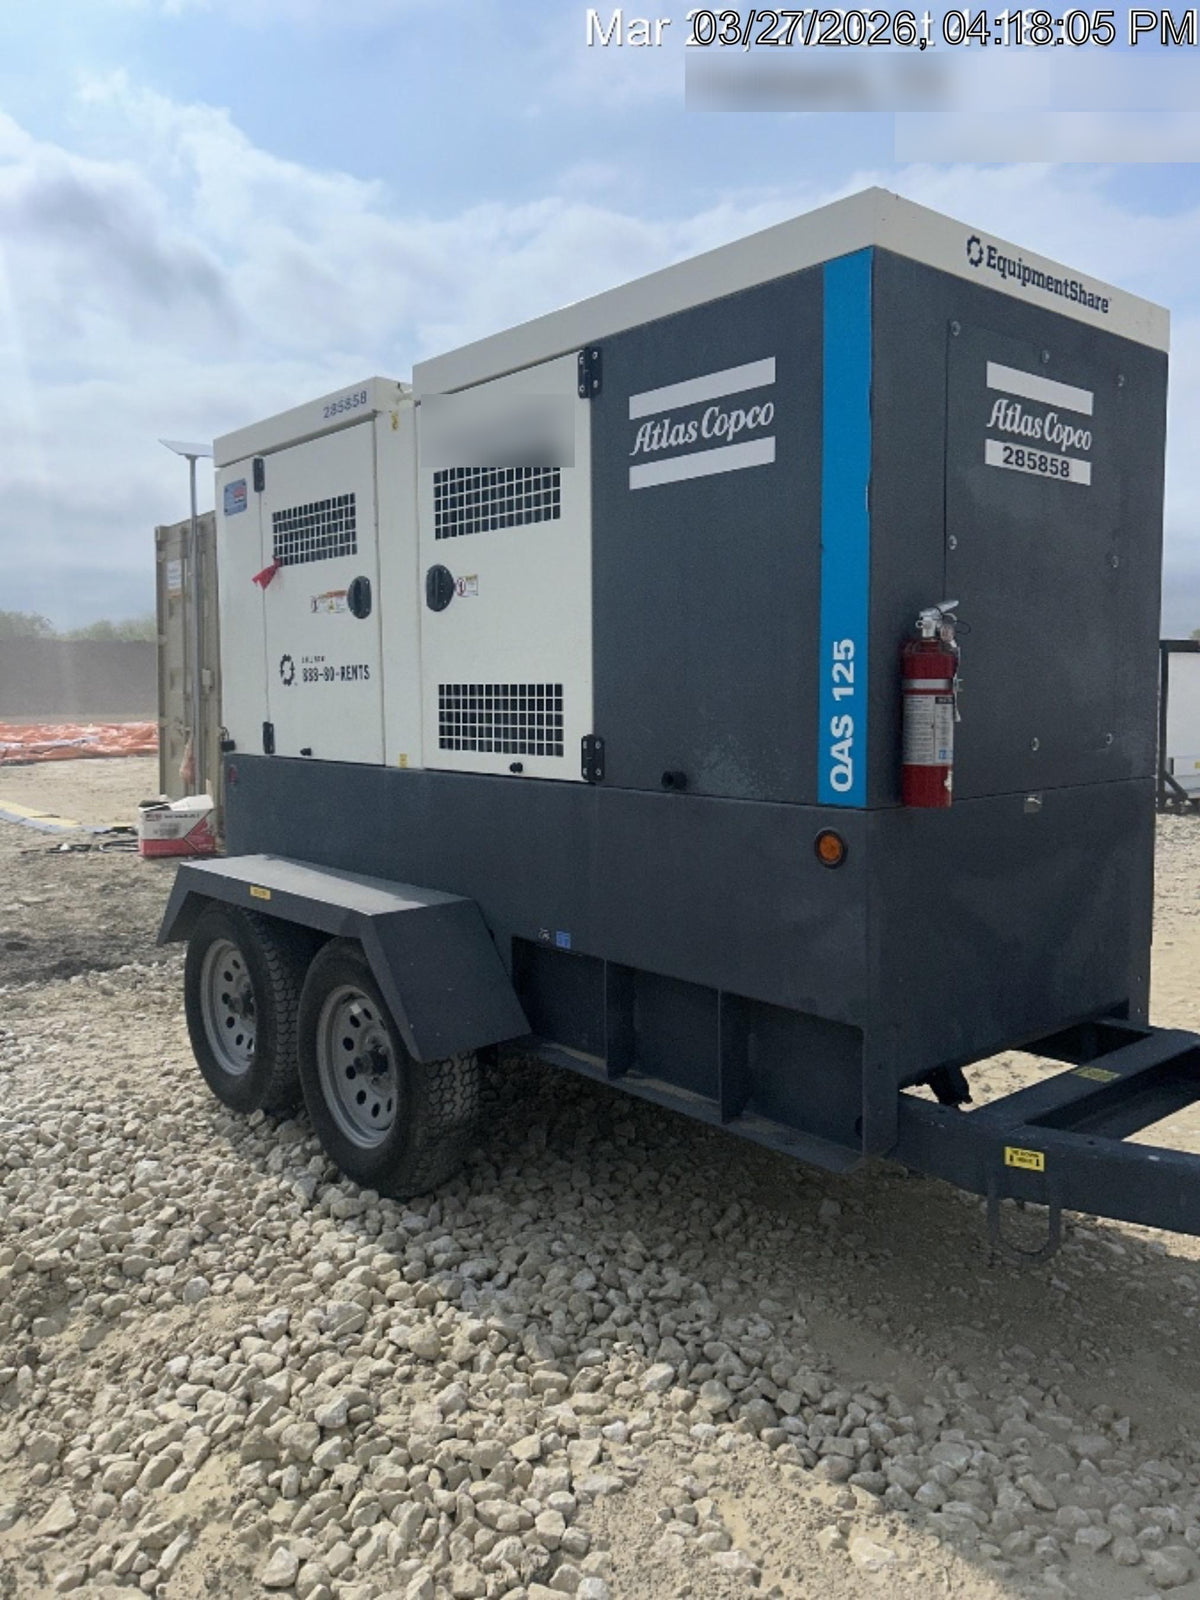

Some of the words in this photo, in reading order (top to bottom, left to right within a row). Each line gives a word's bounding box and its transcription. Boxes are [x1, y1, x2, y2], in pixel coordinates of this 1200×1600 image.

[986, 244, 1110, 314] EquipmentShare
[322, 390, 367, 419] 285858
[629, 418, 698, 456] Atlas
[701, 401, 775, 442] Copco
[986, 398, 1043, 439] Atlas
[1044, 412, 1092, 453] Copco
[1002, 445, 1070, 478] 285858
[832, 638, 855, 701] 125
[830, 714, 854, 792] QAS
